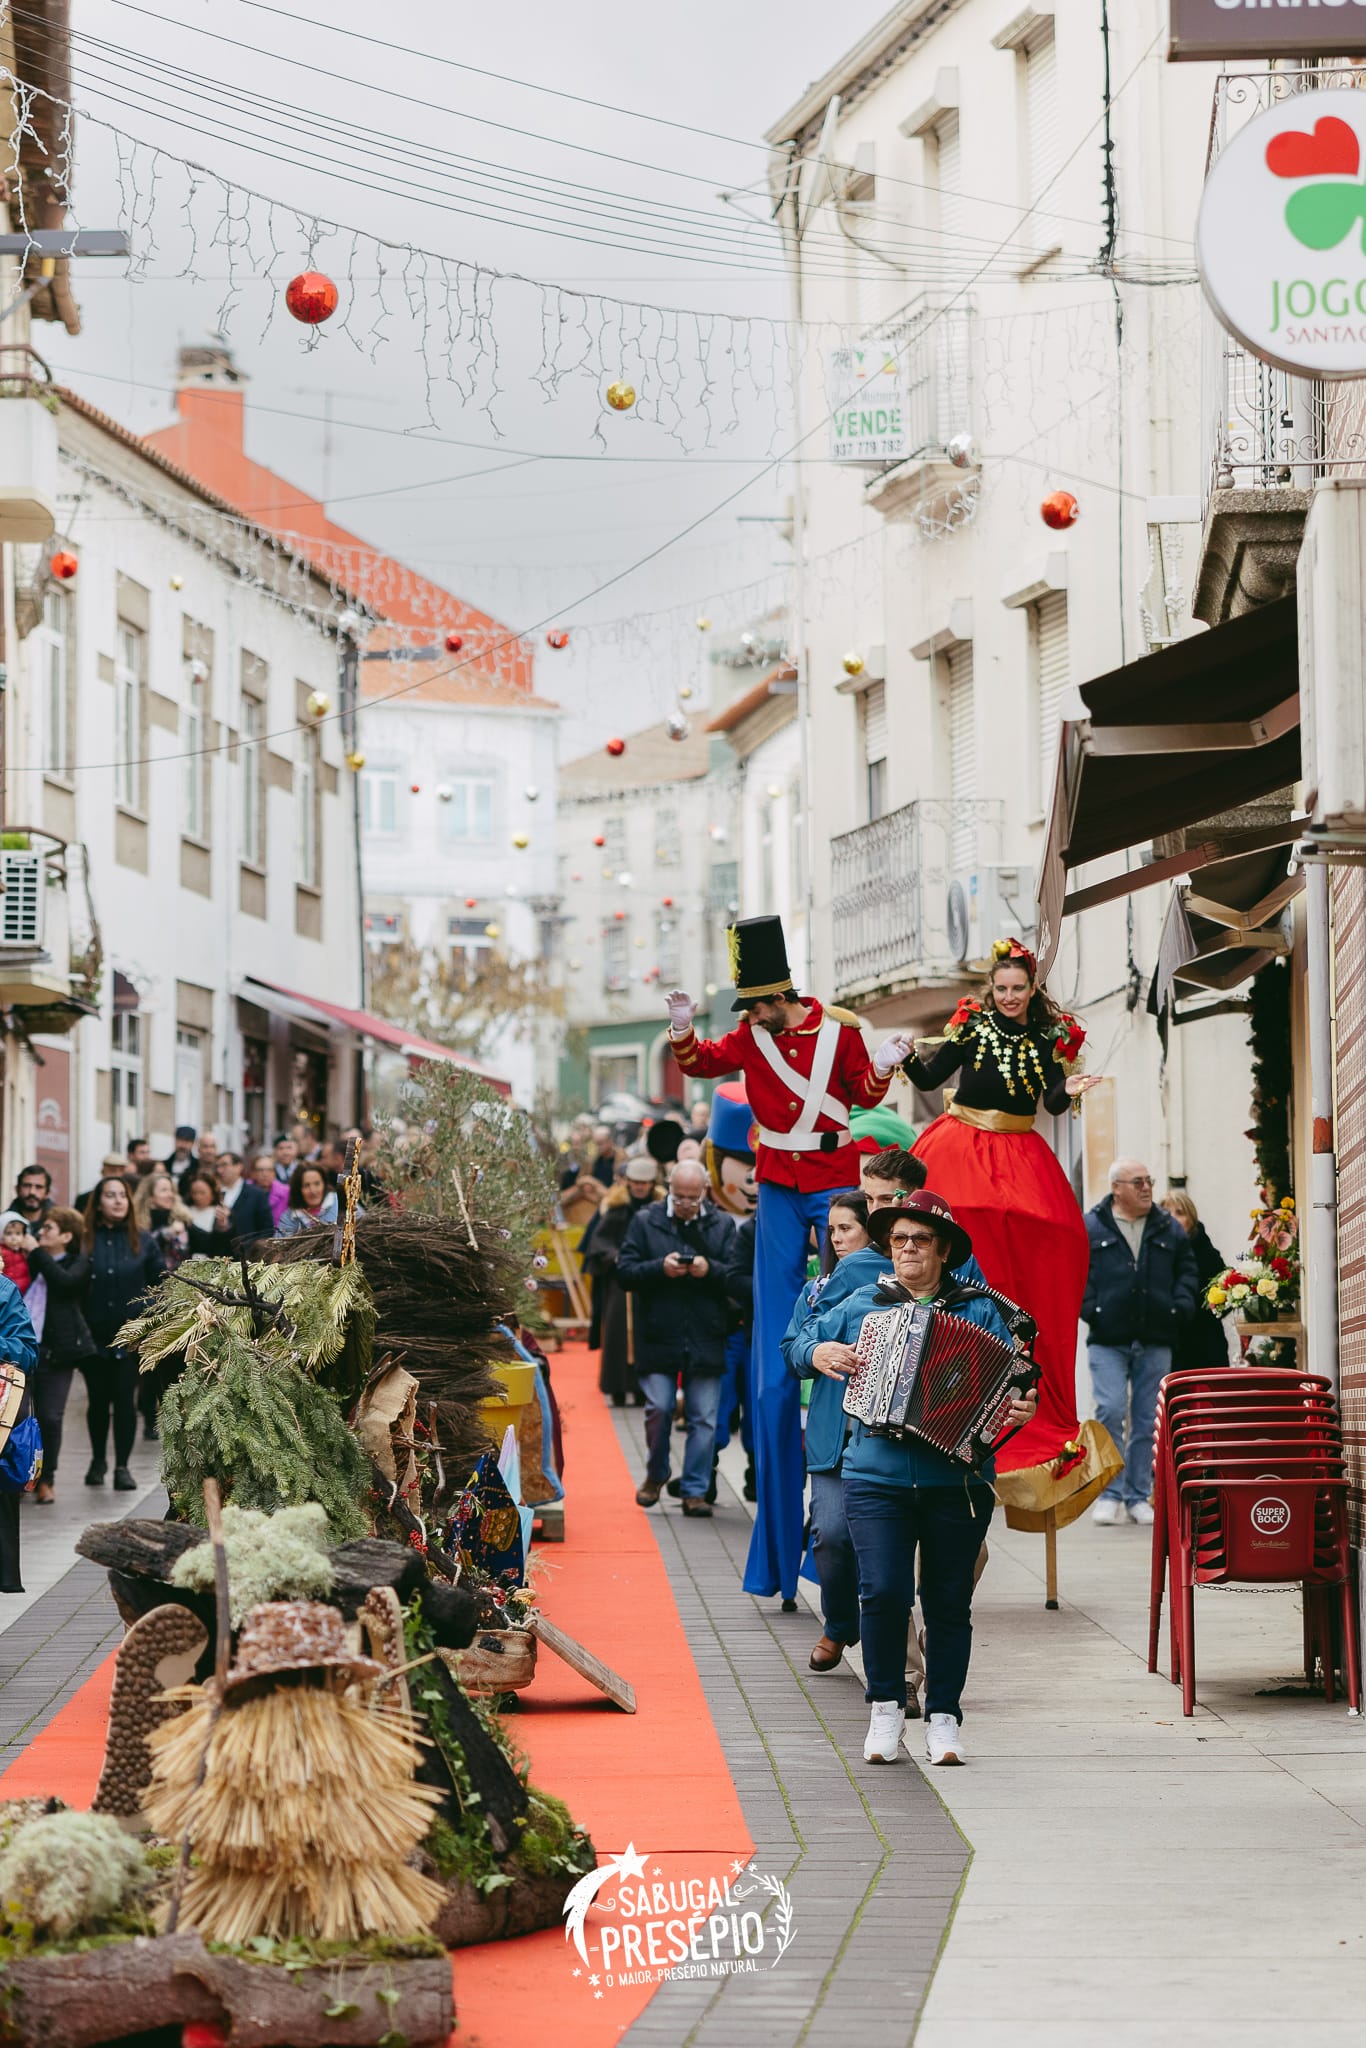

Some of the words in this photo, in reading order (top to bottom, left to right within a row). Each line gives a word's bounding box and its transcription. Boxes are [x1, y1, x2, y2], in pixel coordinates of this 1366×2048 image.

[832, 408, 902, 438] VENDE
[970, 1380, 1008, 1434] Superleggera
[1256, 1507, 1285, 1515] SUPER
[1257, 1515, 1284, 1523] BOCK
